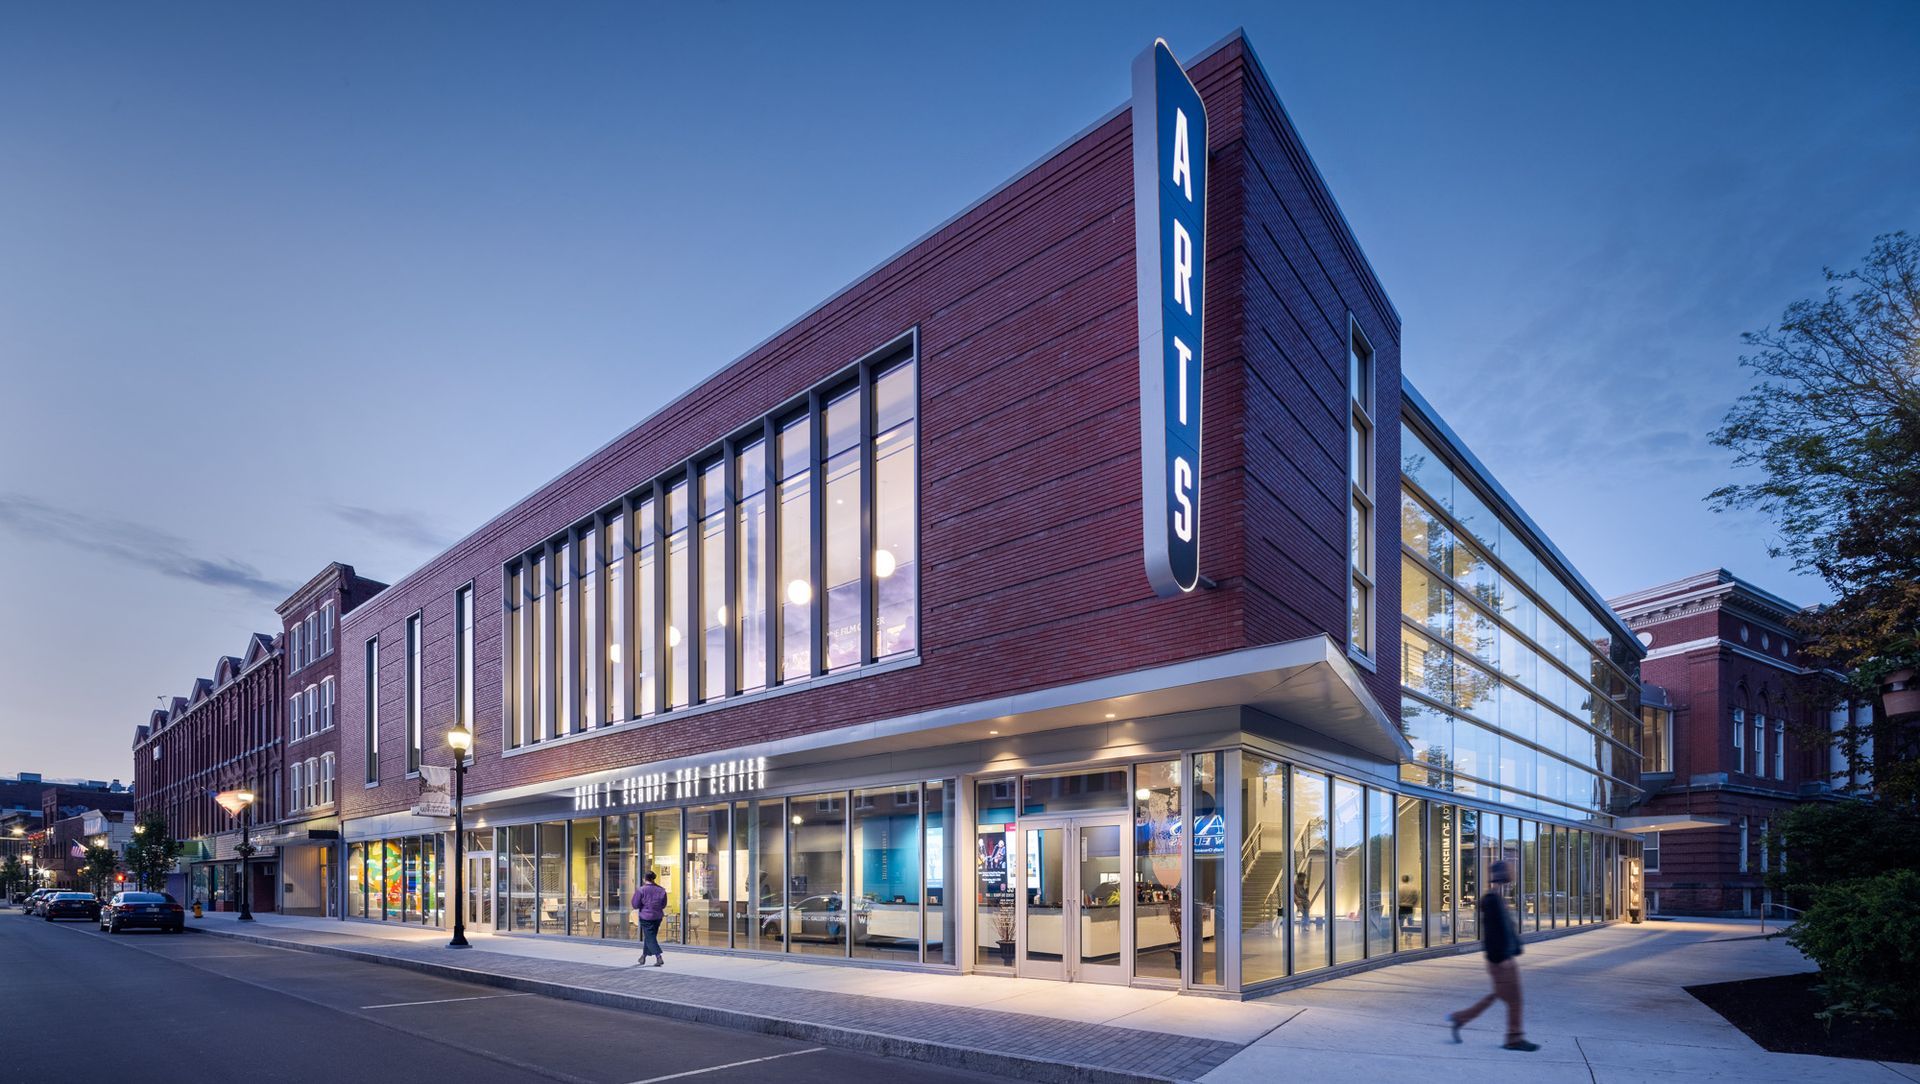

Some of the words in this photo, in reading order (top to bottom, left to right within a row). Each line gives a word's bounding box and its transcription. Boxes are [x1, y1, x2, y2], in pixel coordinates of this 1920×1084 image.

[1172, 107, 1193, 544] ARTS
[575, 793, 599, 810] PAUL
[605, 791, 616, 807] J.
[623, 784, 667, 805] SCHUPF
[676, 780, 700, 798] ART
[710, 771, 765, 795] CENTER
